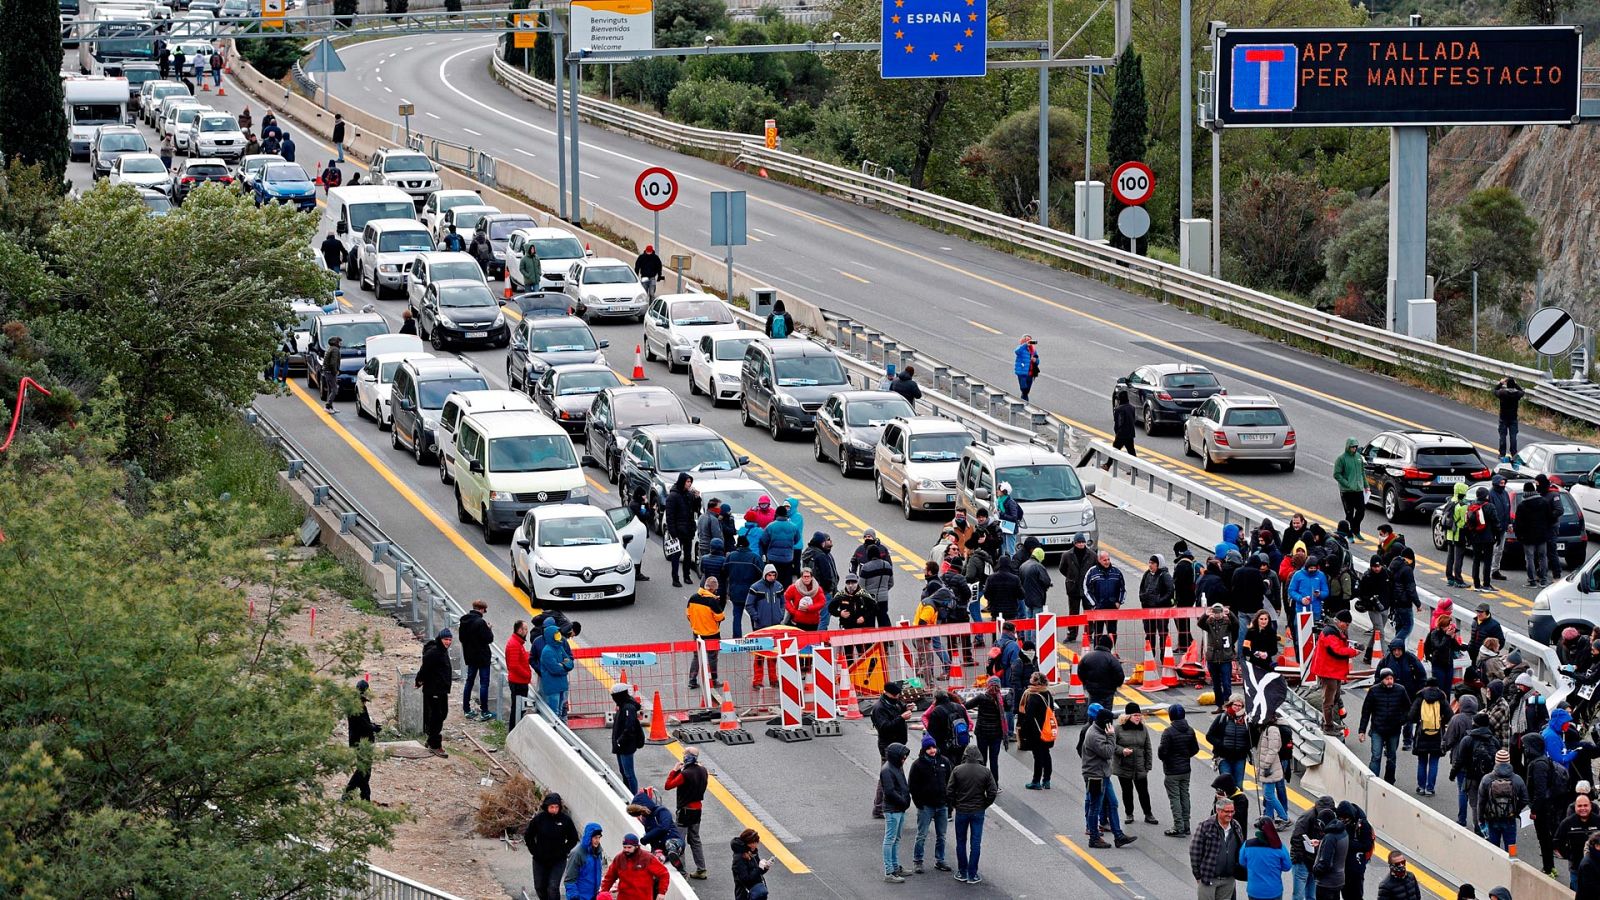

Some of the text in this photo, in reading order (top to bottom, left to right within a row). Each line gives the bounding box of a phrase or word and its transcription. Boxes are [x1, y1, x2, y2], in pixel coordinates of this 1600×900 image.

[590, 17, 628, 25] Benvinguts
[907, 11, 961, 24] ESPAÑA
[590, 25, 630, 33] Bienvenidos
[1302, 41, 1481, 61] AP7 TALLADA
[1301, 66, 1562, 87] PER MANIFESTACIO
[1119, 176, 1148, 191] 100
